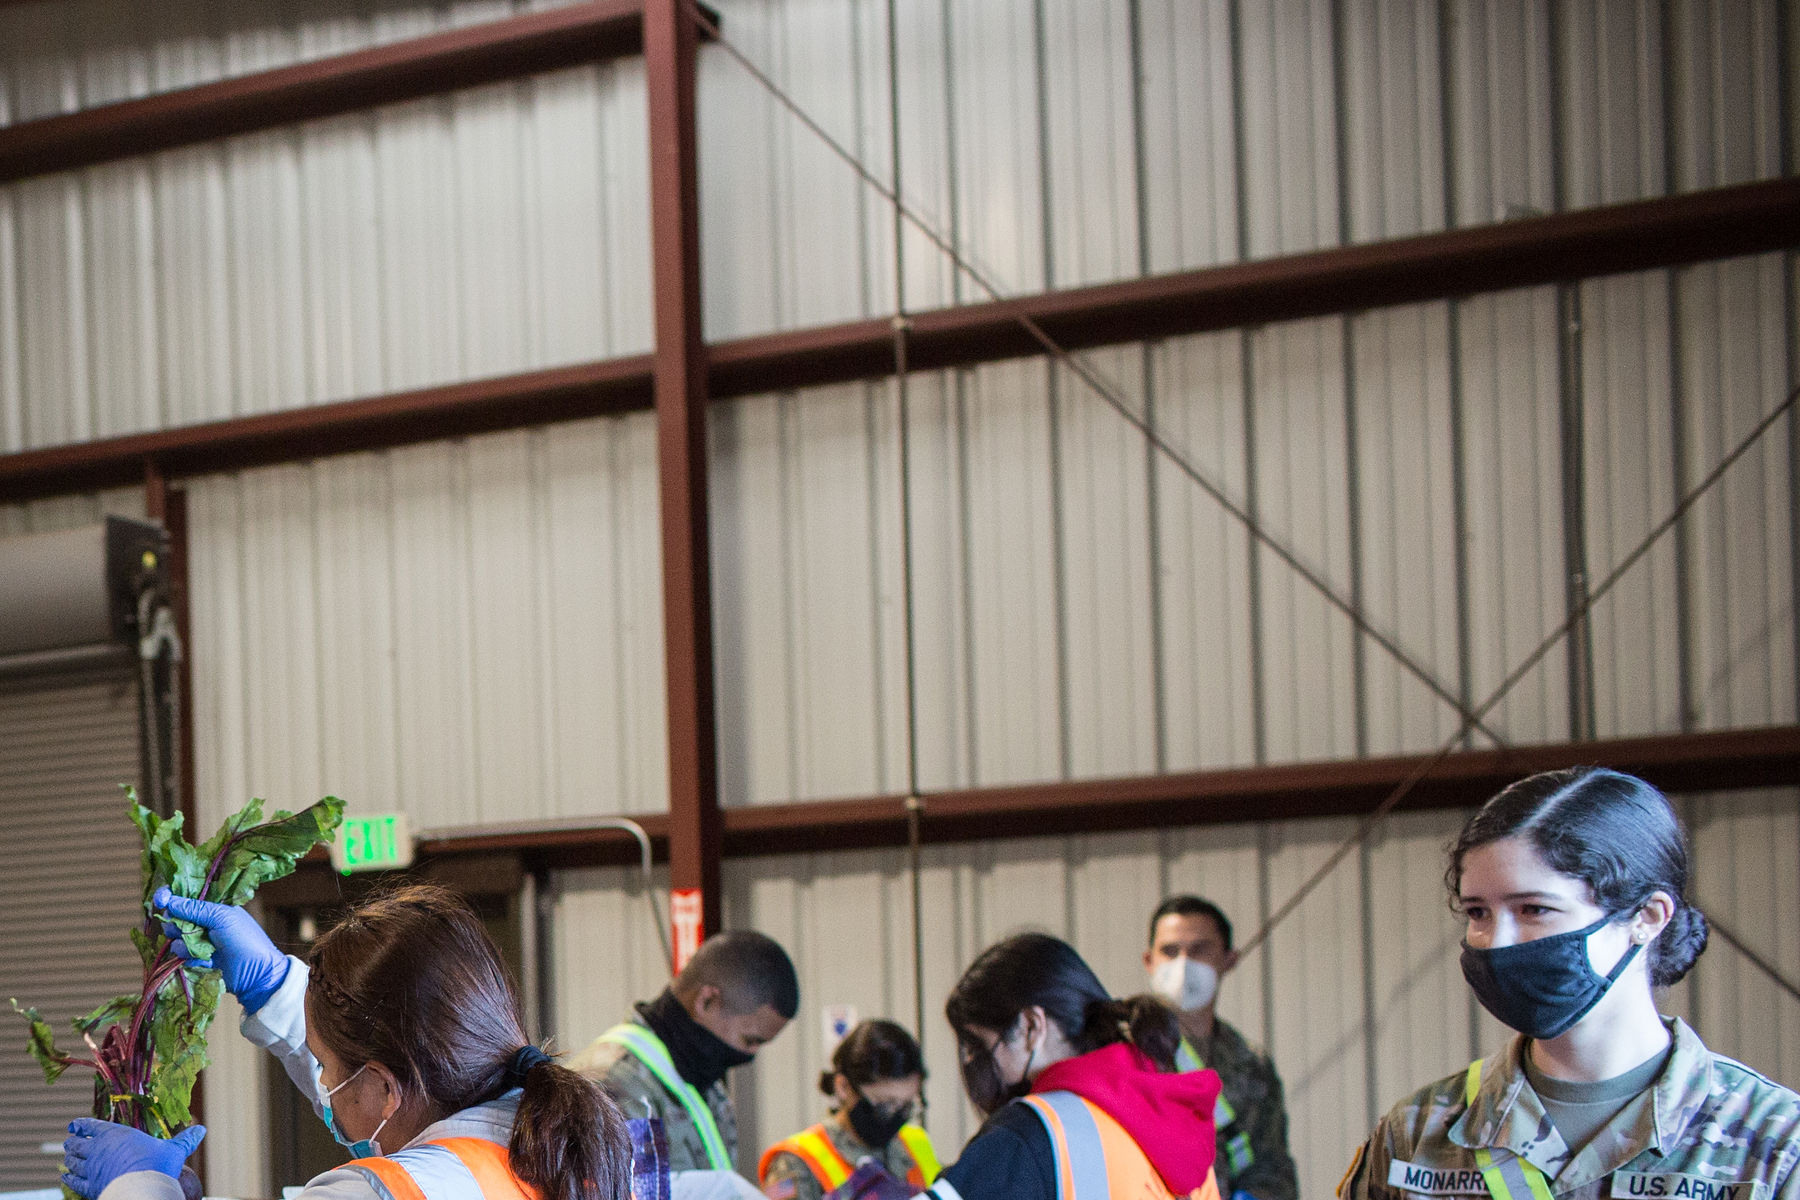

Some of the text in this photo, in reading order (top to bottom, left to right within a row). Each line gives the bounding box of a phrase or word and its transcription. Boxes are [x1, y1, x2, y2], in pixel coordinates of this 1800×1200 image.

[343, 815, 396, 865] EXIT
[1404, 1166, 1489, 1191] MONARR
[1629, 1173, 1669, 1197] U.S.
